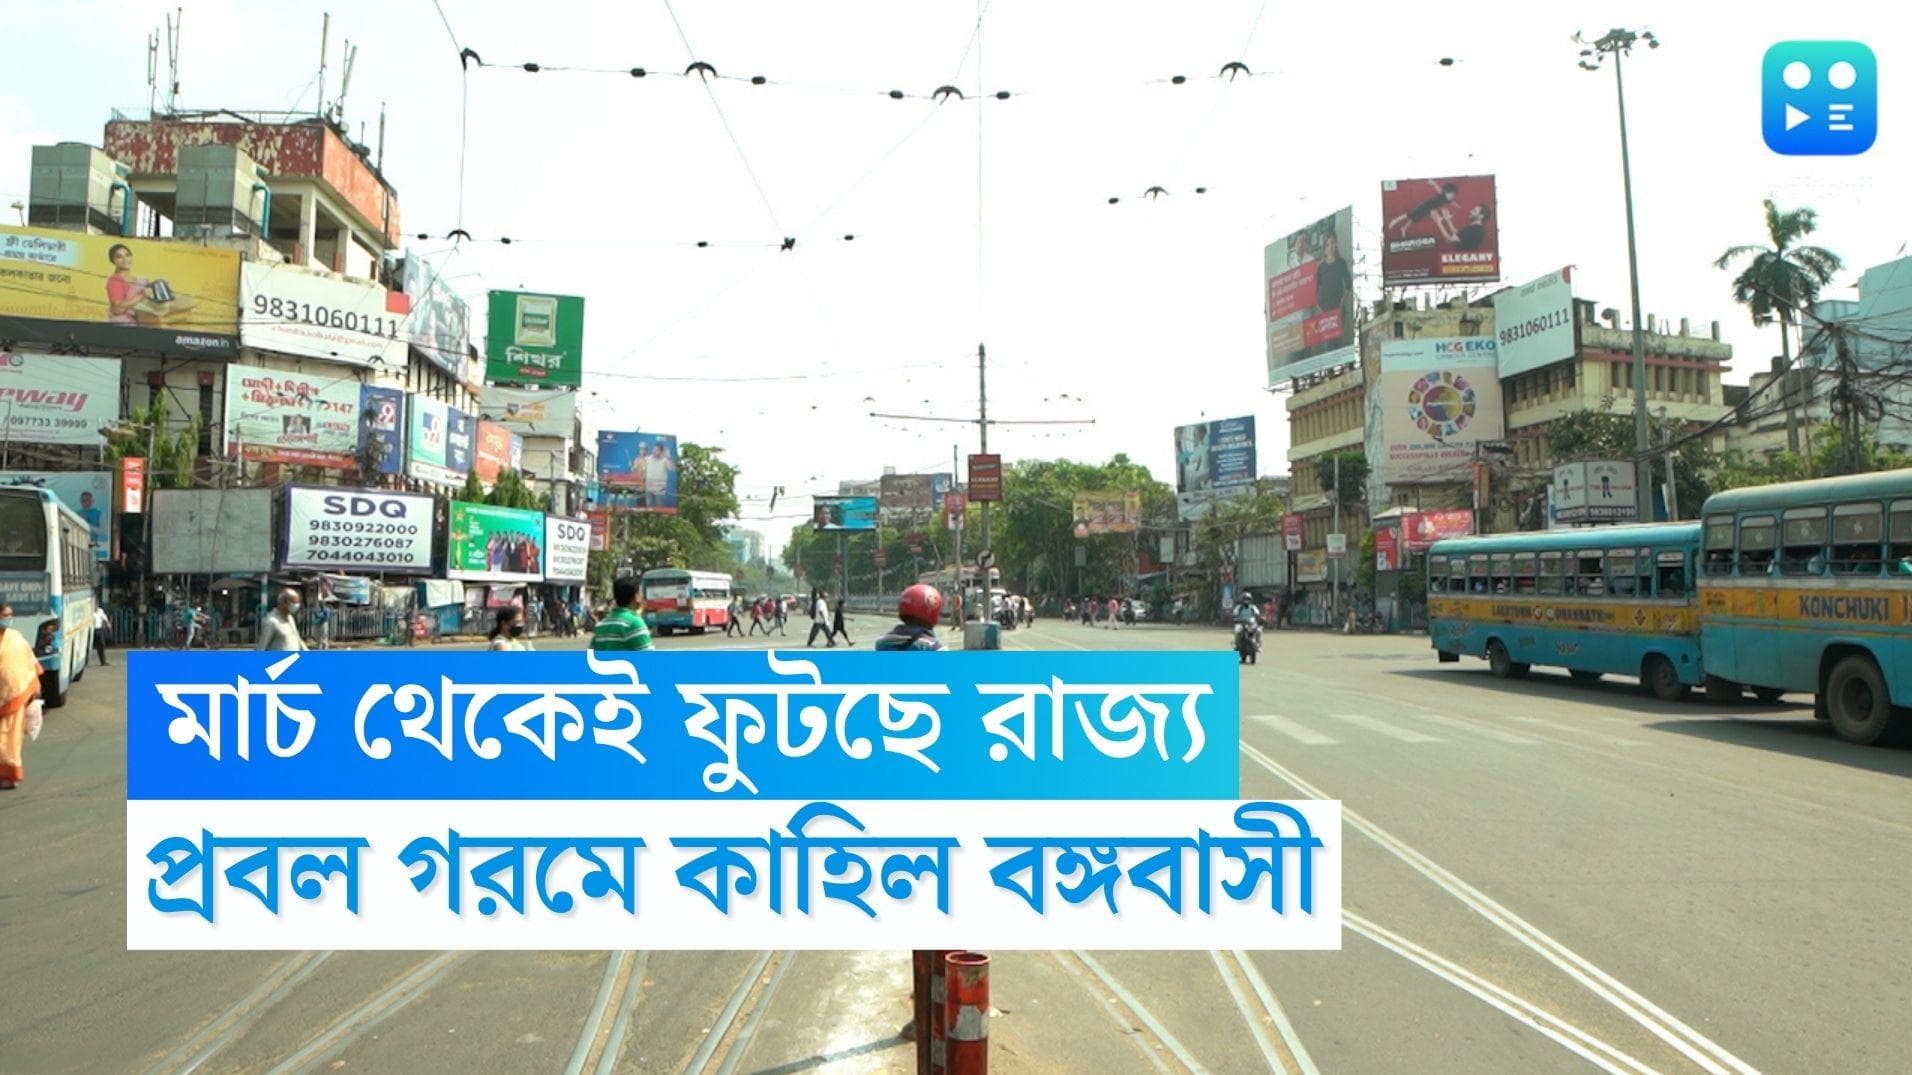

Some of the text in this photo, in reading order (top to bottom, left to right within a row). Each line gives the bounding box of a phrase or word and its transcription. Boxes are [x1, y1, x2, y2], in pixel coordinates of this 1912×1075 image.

[1440, 253, 1494, 264] ELEGANT
[253, 294, 399, 340] 9831060111
[1499, 307, 1570, 347] 9831060111
[174, 334, 230, 348] amazon.in
[1435, 341, 1464, 354] HCG
[1465, 340, 1497, 353] EKO
[323, 495, 407, 518] SDQ
[309, 520, 418, 535] 9830922000
[557, 523, 586, 541] SDQ
[308, 535, 413, 549] 9830276087
[306, 550, 414, 564] 7044043010
[1800, 595, 1889, 621] KONCHUKI
